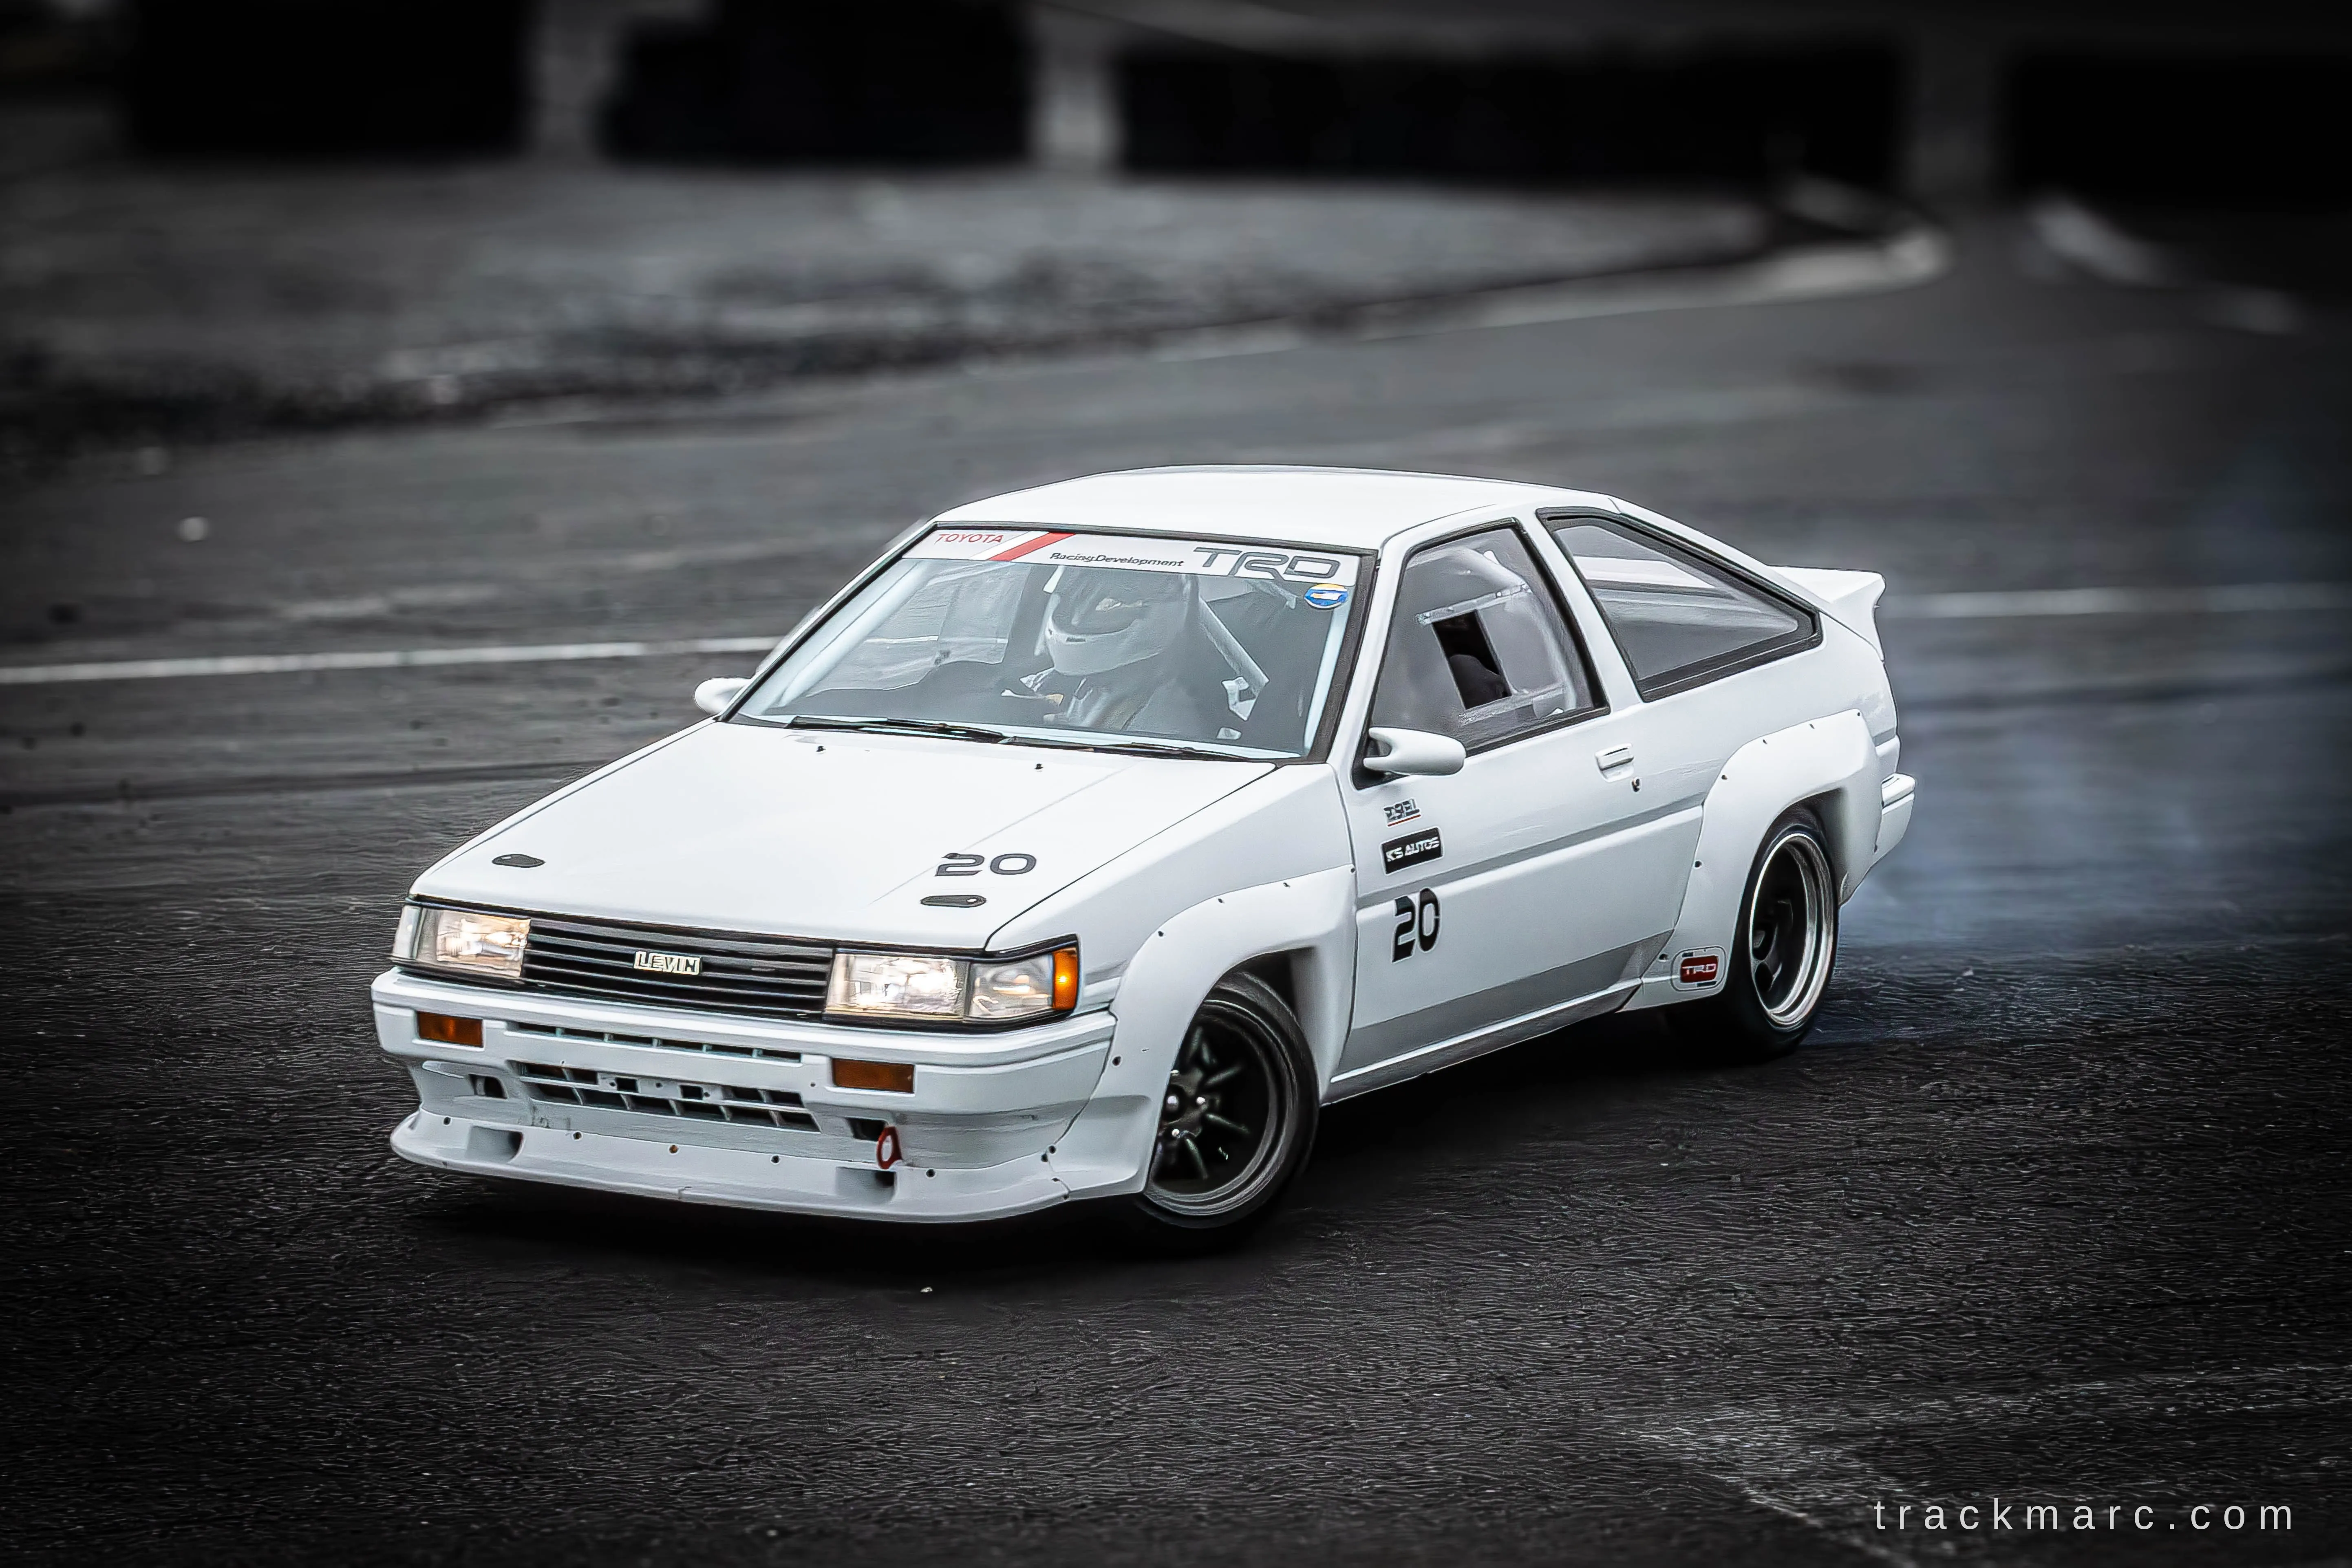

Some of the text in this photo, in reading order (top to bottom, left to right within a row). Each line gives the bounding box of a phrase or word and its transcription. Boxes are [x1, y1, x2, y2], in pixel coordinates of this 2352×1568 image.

[935, 534, 1003, 543] TOYOTA
[1193, 547, 1341, 580] TRD
[1405, 836, 1439, 856] AUTOS
[935, 853, 1037, 876] 20
[1392, 888, 1439, 963] 20
[633, 951, 700, 975] LEVIN
[1681, 963, 1716, 975] TRD
